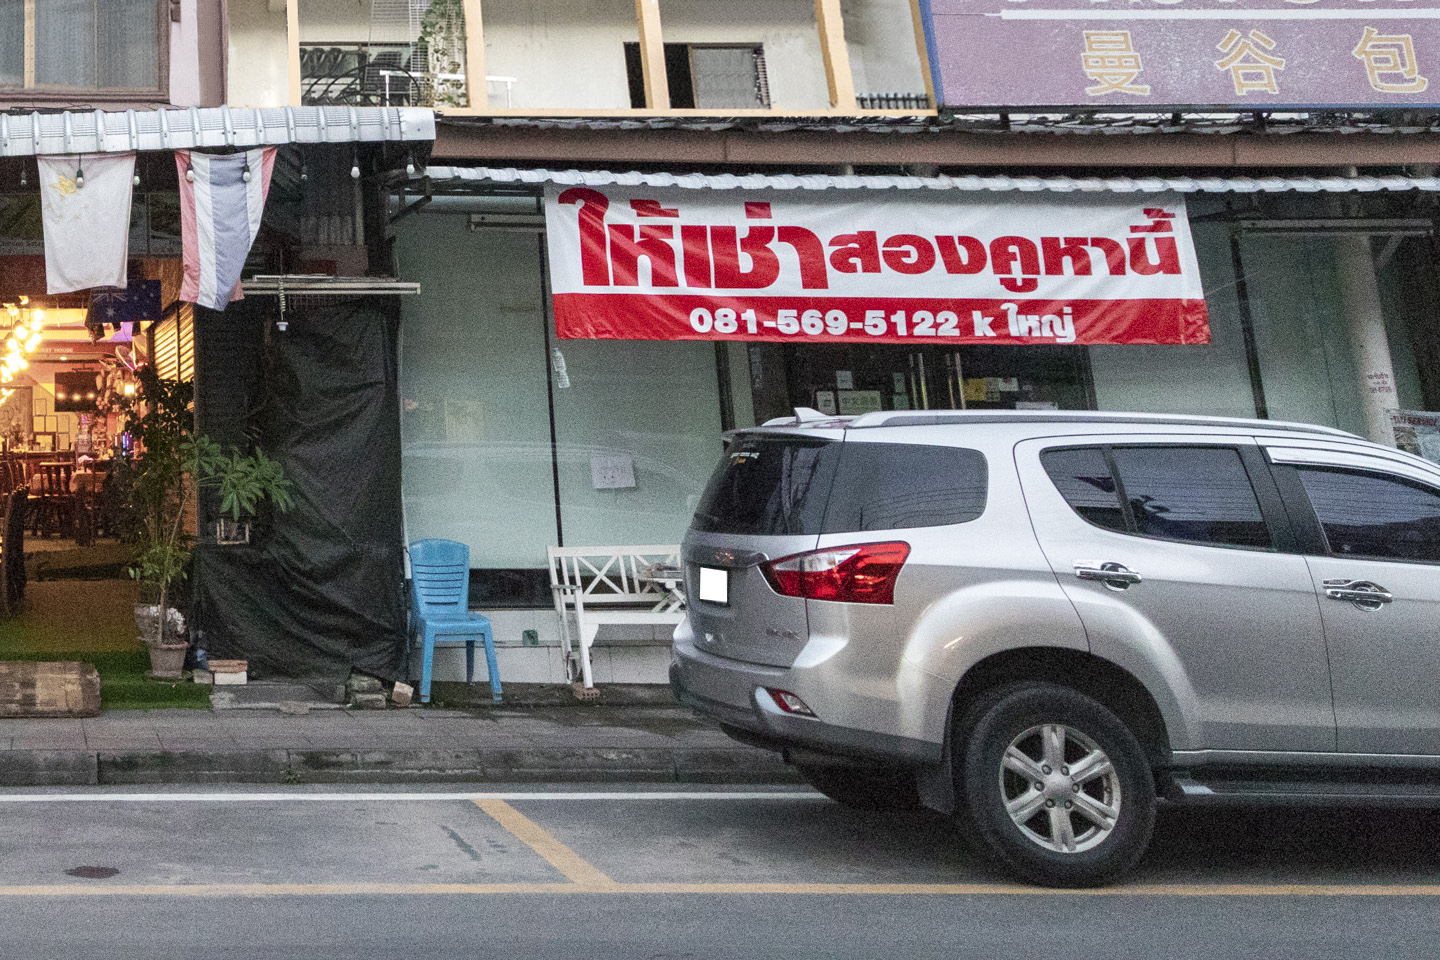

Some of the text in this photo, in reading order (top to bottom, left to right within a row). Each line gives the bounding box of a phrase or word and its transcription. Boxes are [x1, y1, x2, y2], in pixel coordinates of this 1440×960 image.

[1080, 26, 1429, 97] 曼谷包
[690, 306, 959, 336] 081-569-5122
[1001, 303, 1077, 344] ใหญ่
